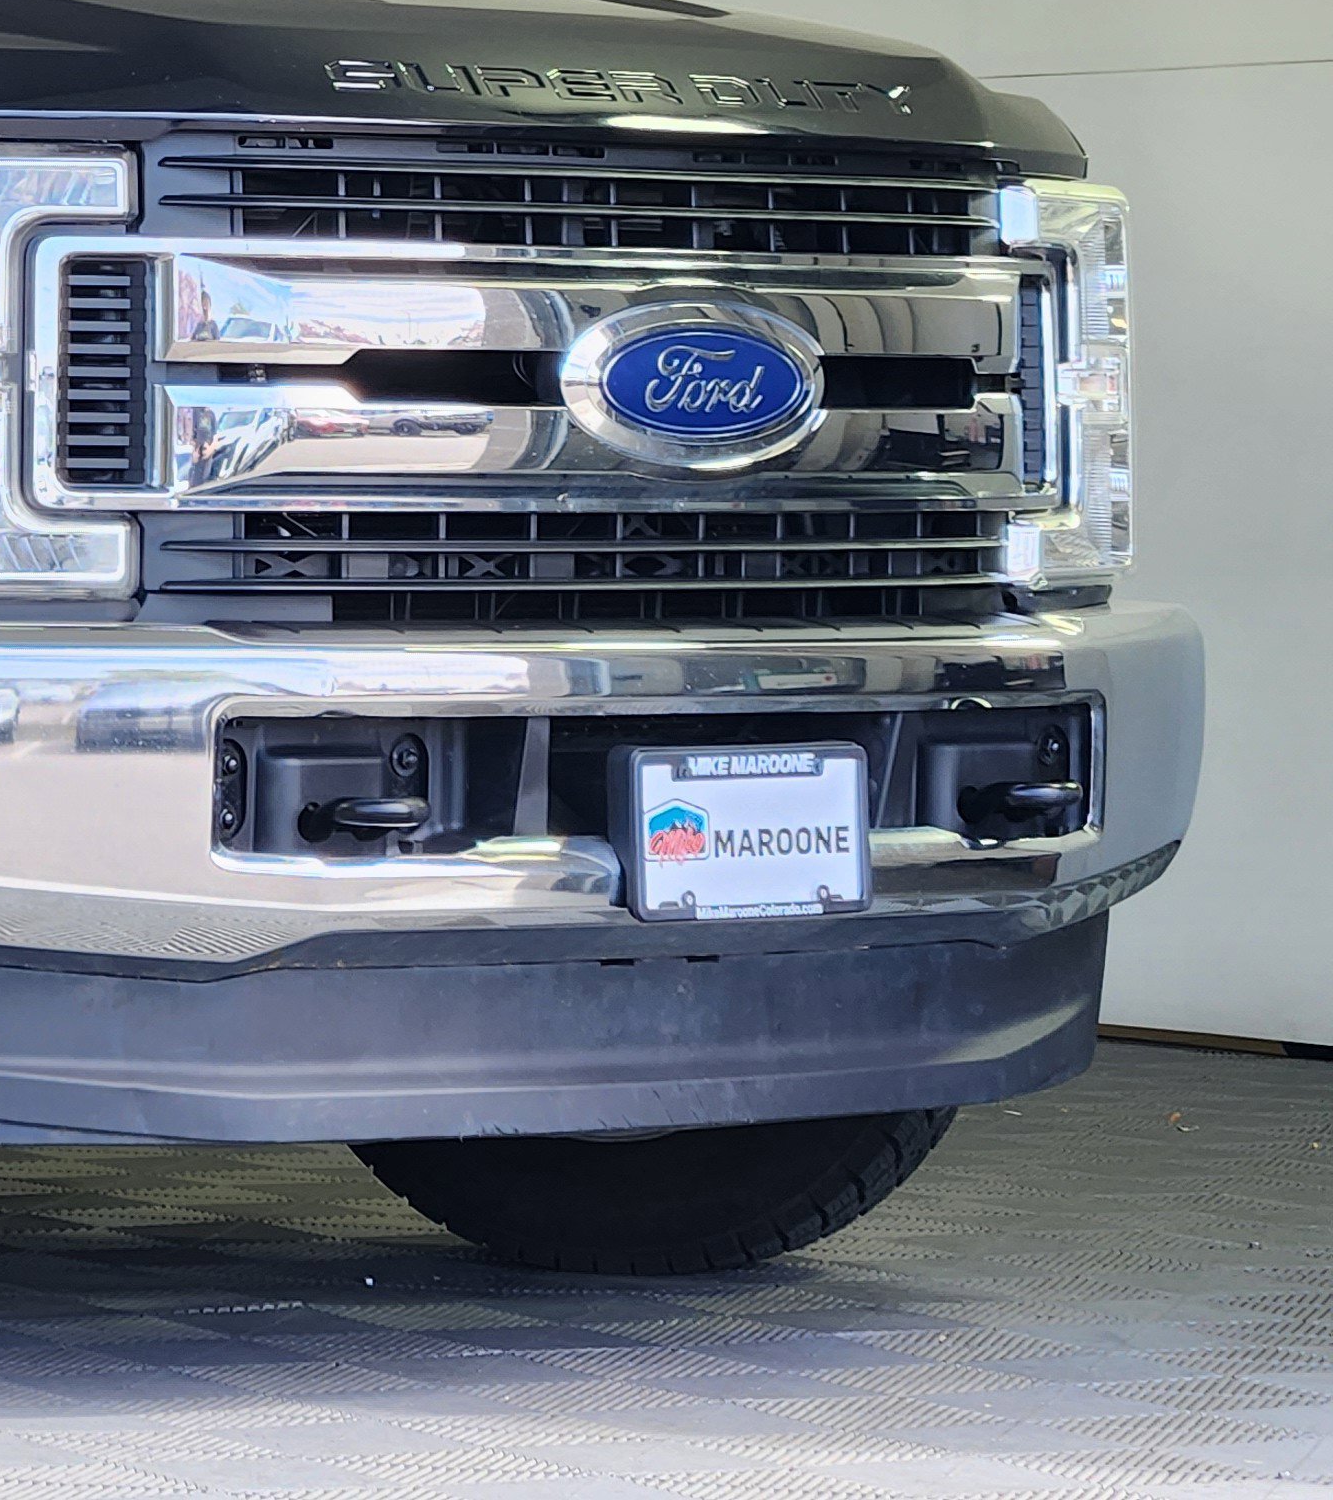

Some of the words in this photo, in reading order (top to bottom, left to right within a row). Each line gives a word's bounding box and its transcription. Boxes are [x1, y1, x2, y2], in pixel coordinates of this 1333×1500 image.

[324, 59, 683, 104] SUPER
[689, 74, 913, 116] DUTY
[646, 345, 765, 413] Ford
[687, 755, 729, 776] MIKE
[731, 752, 815, 775] MAROONE
[714, 826, 851, 858] MAROONE
